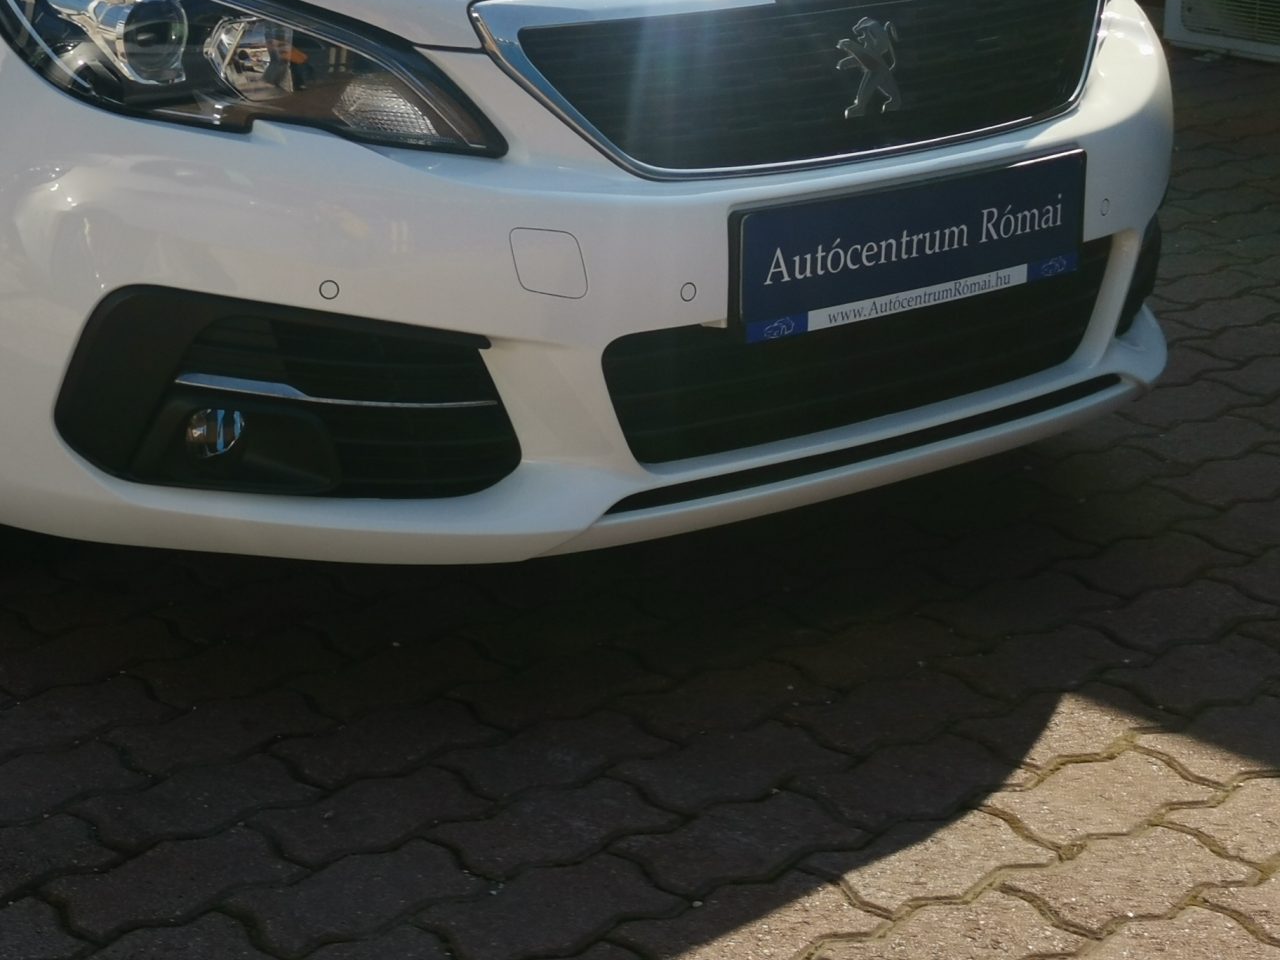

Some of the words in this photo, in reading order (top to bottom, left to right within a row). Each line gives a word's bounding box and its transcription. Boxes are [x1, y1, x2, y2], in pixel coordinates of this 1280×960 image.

[764, 222, 968, 286] Autócentrum
[980, 194, 1063, 244] Római
[827, 271, 1011, 325] www.AutócentrumRómai.hu
